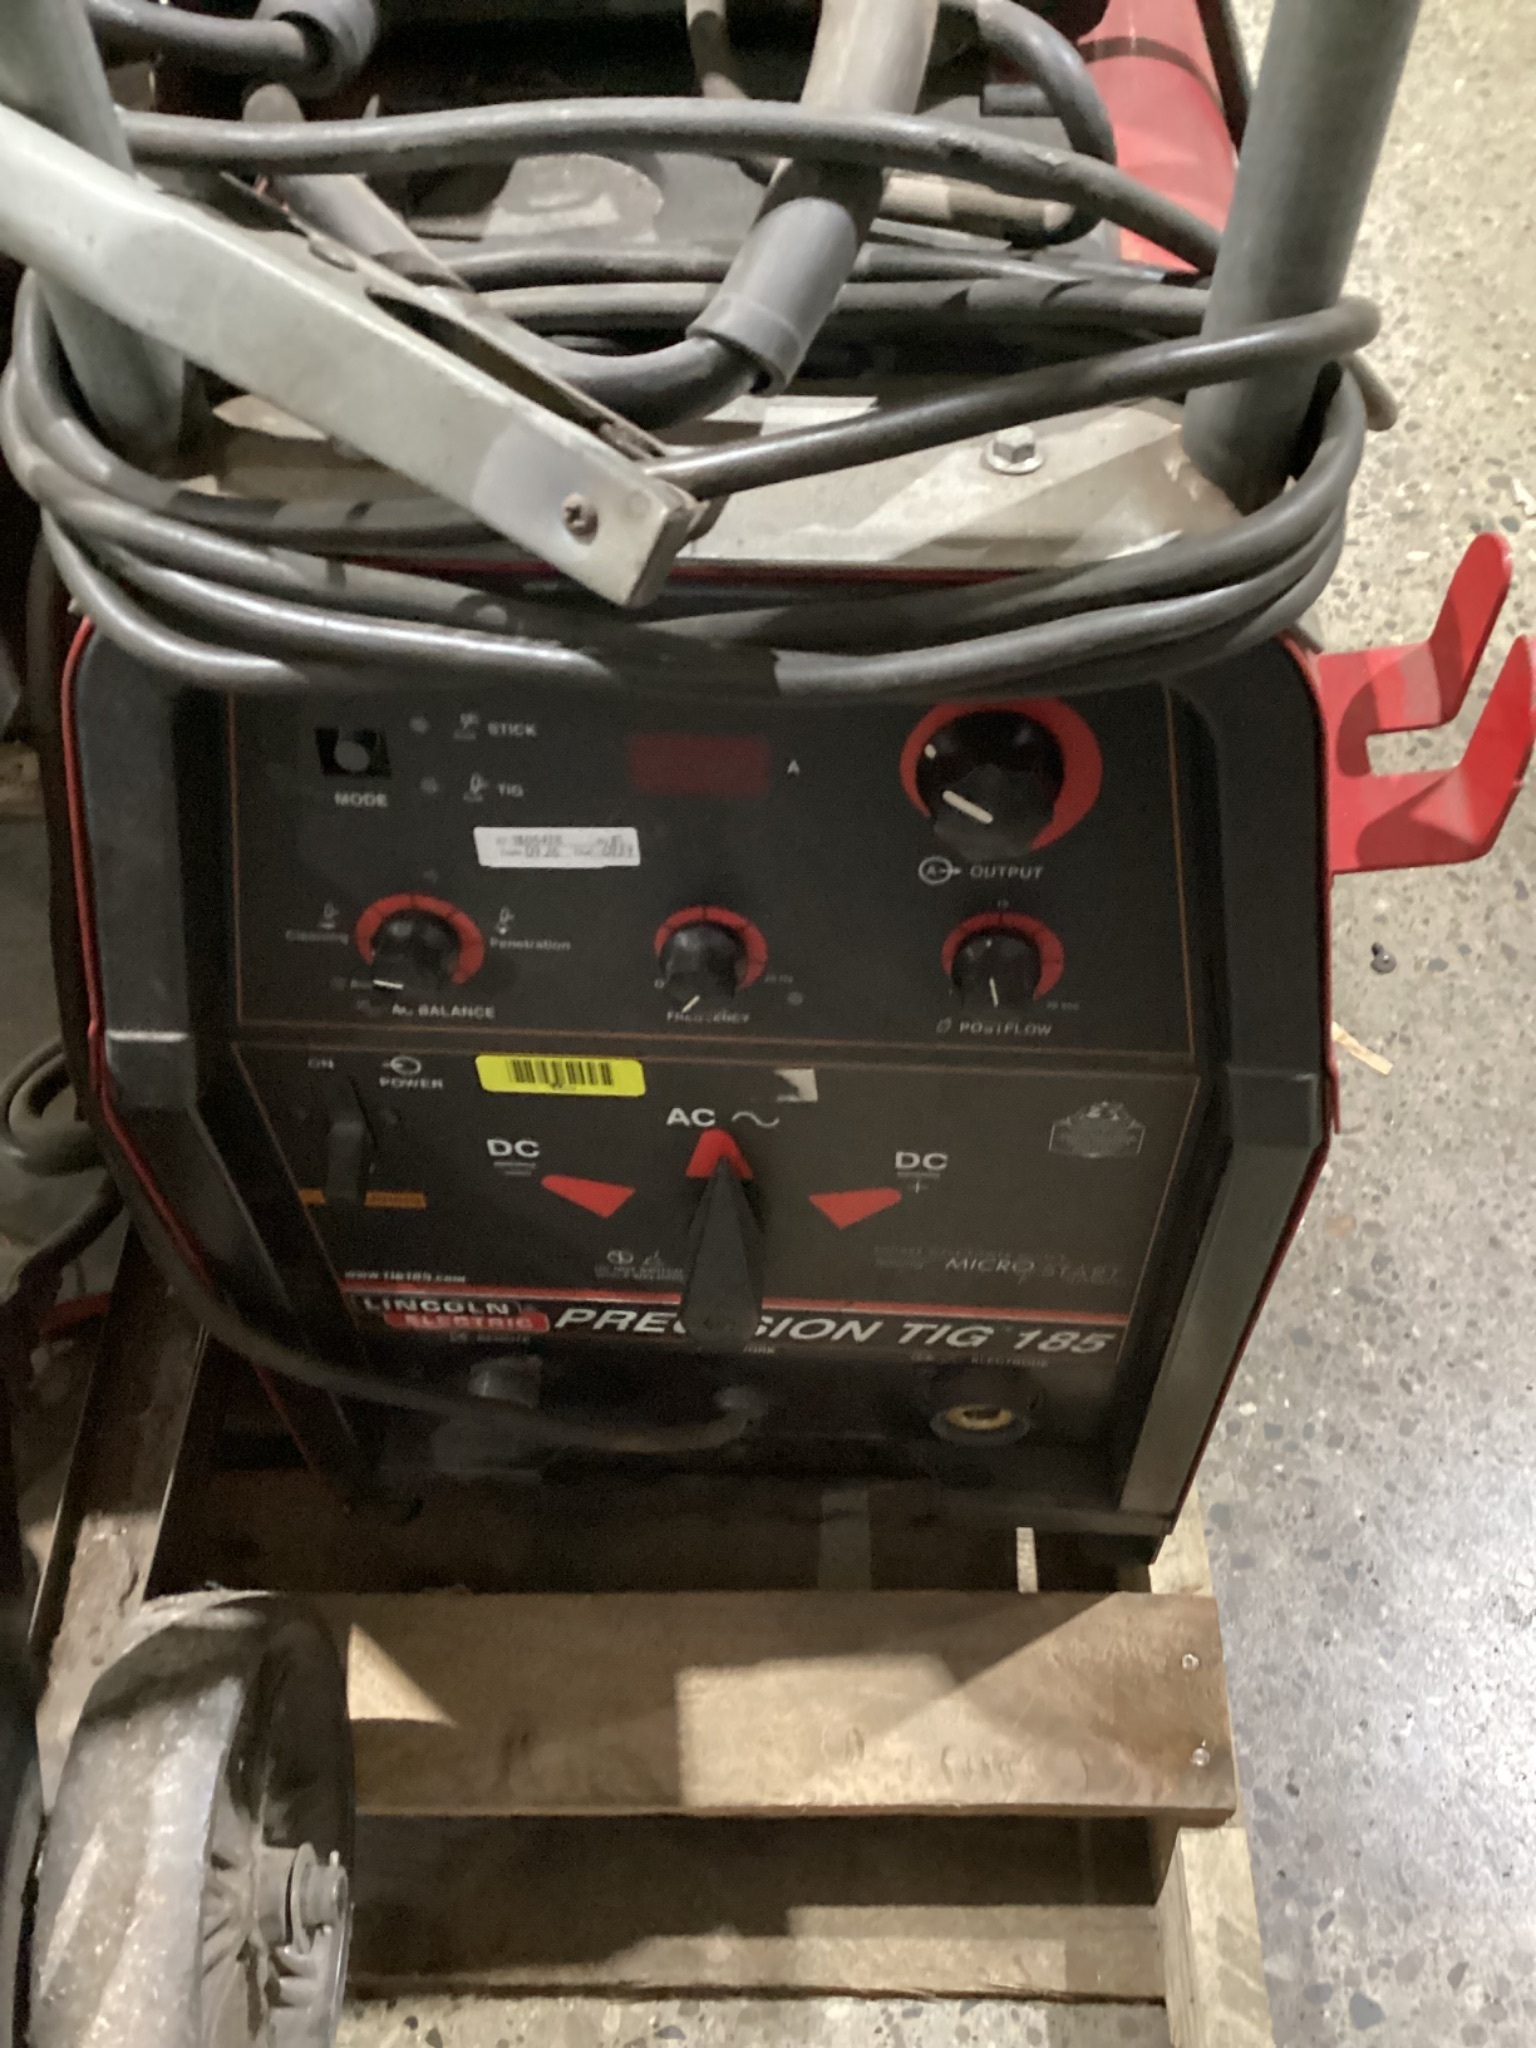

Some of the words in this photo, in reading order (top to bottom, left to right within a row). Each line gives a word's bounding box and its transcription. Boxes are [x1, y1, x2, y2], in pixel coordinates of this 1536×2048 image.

[488, 722, 537, 737] STICK
[787, 759, 800, 775] A
[498, 783, 525, 798] TIG
[335, 792, 388, 808] MODE
[970, 864, 1043, 880] OUTPUT
[490, 937, 571, 952] Penetration
[418, 1004, 496, 1019] BALANCE
[307, 1057, 334, 1070] ON
[379, 1076, 444, 1090] POWER
[666, 1108, 716, 1128] AC
[486, 1138, 540, 1158] DC
[895, 1151, 949, 1171] DC
[363, 1297, 510, 1315] LINCOLN
[404, 1313, 533, 1331] ELECTRIC
[897, 1321, 993, 1349] TIG
[1013, 1328, 1117, 1354] 185
